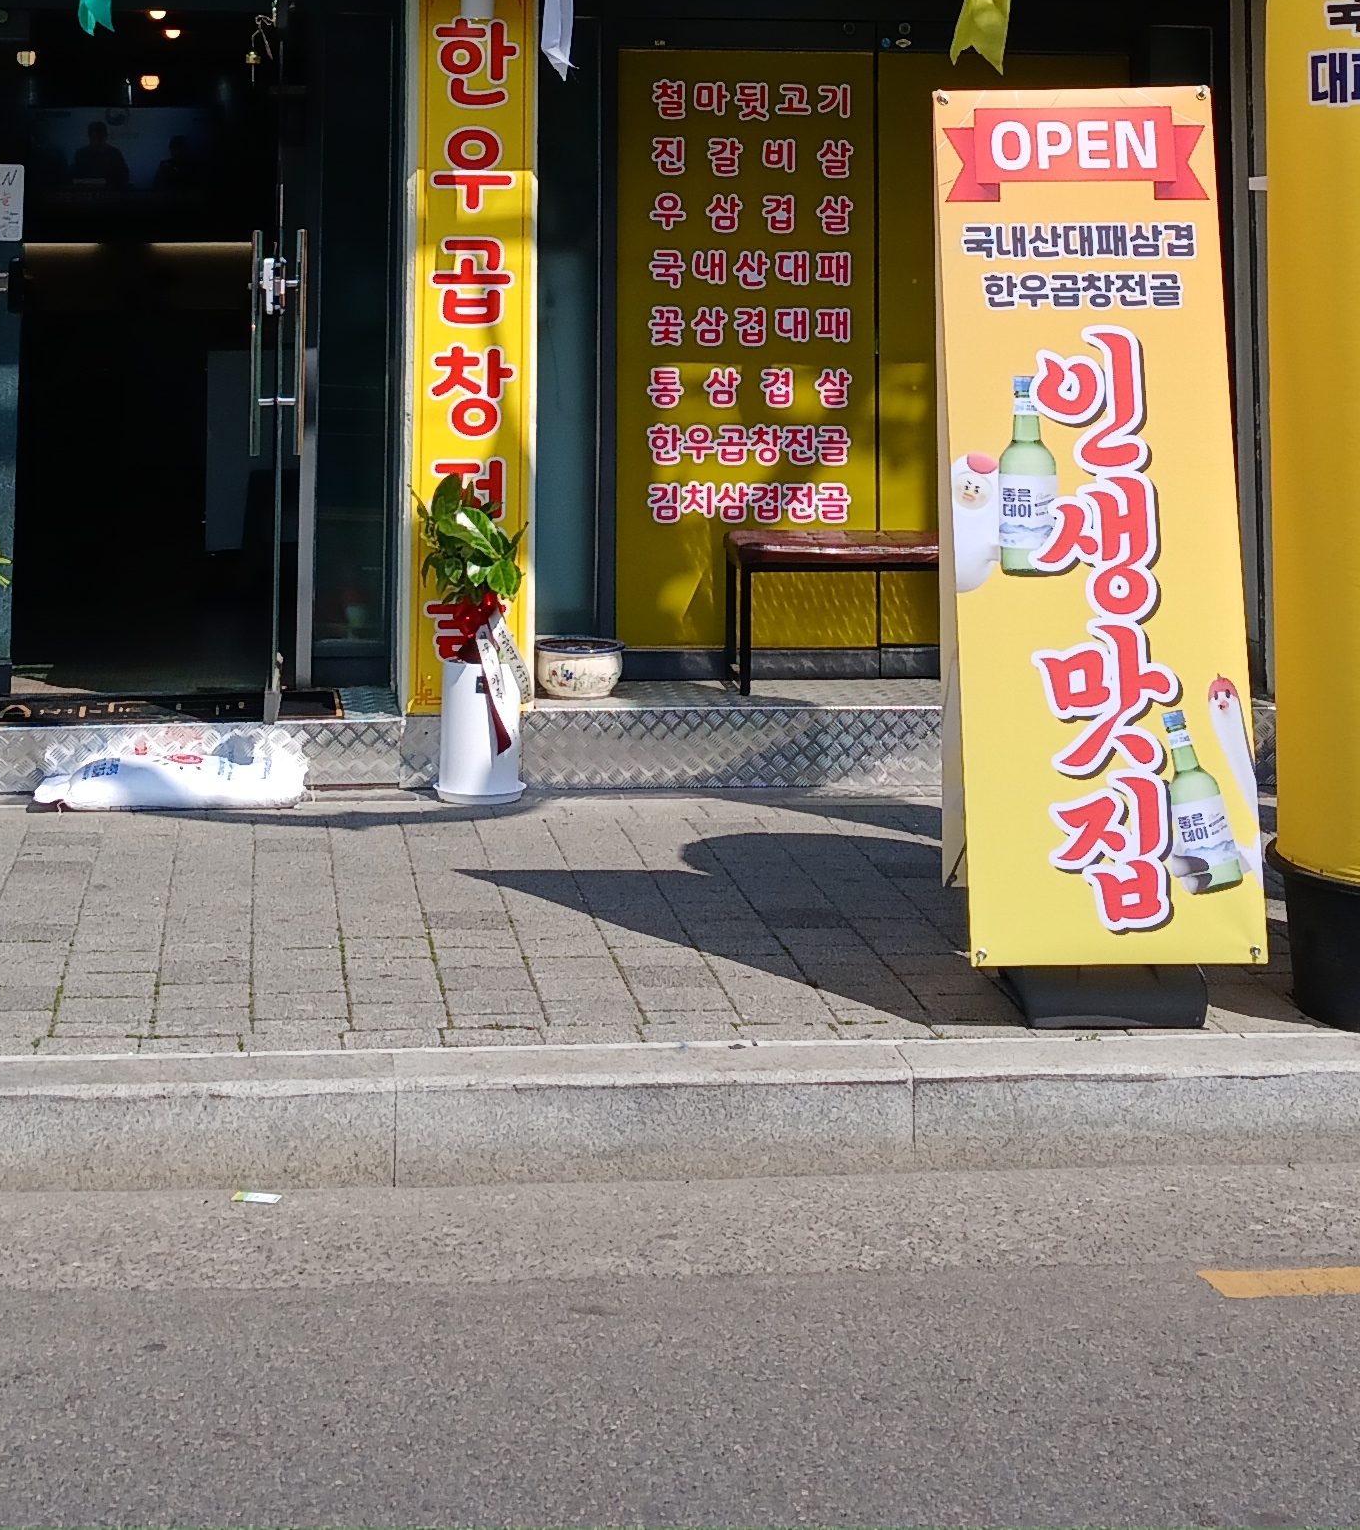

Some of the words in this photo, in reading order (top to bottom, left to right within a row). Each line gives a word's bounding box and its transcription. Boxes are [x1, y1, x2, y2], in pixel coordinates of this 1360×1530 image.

[651, 78, 852, 122] 철마뒷고기
[650, 136, 854, 178] 진갈비살
[990, 119, 1159, 171] OPEN
[650, 192, 854, 235] 우삼겹살
[962, 222, 1196, 260] 국내산대패삼겹
[649, 249, 852, 289] 국내산대패
[982, 271, 1183, 310] 한우곱창전골
[648, 305, 852, 347] 꽃삼겹대패
[647, 366, 852, 409] 통삼겹살
[647, 423, 851, 467] 한우곱창전골
[648, 480, 851, 524] 김치삼겹전골
[1002, 487, 1031, 503] 좋은
[1002, 503, 1032, 518] 데이
[1035, 329, 1173, 924] 인생맛집
